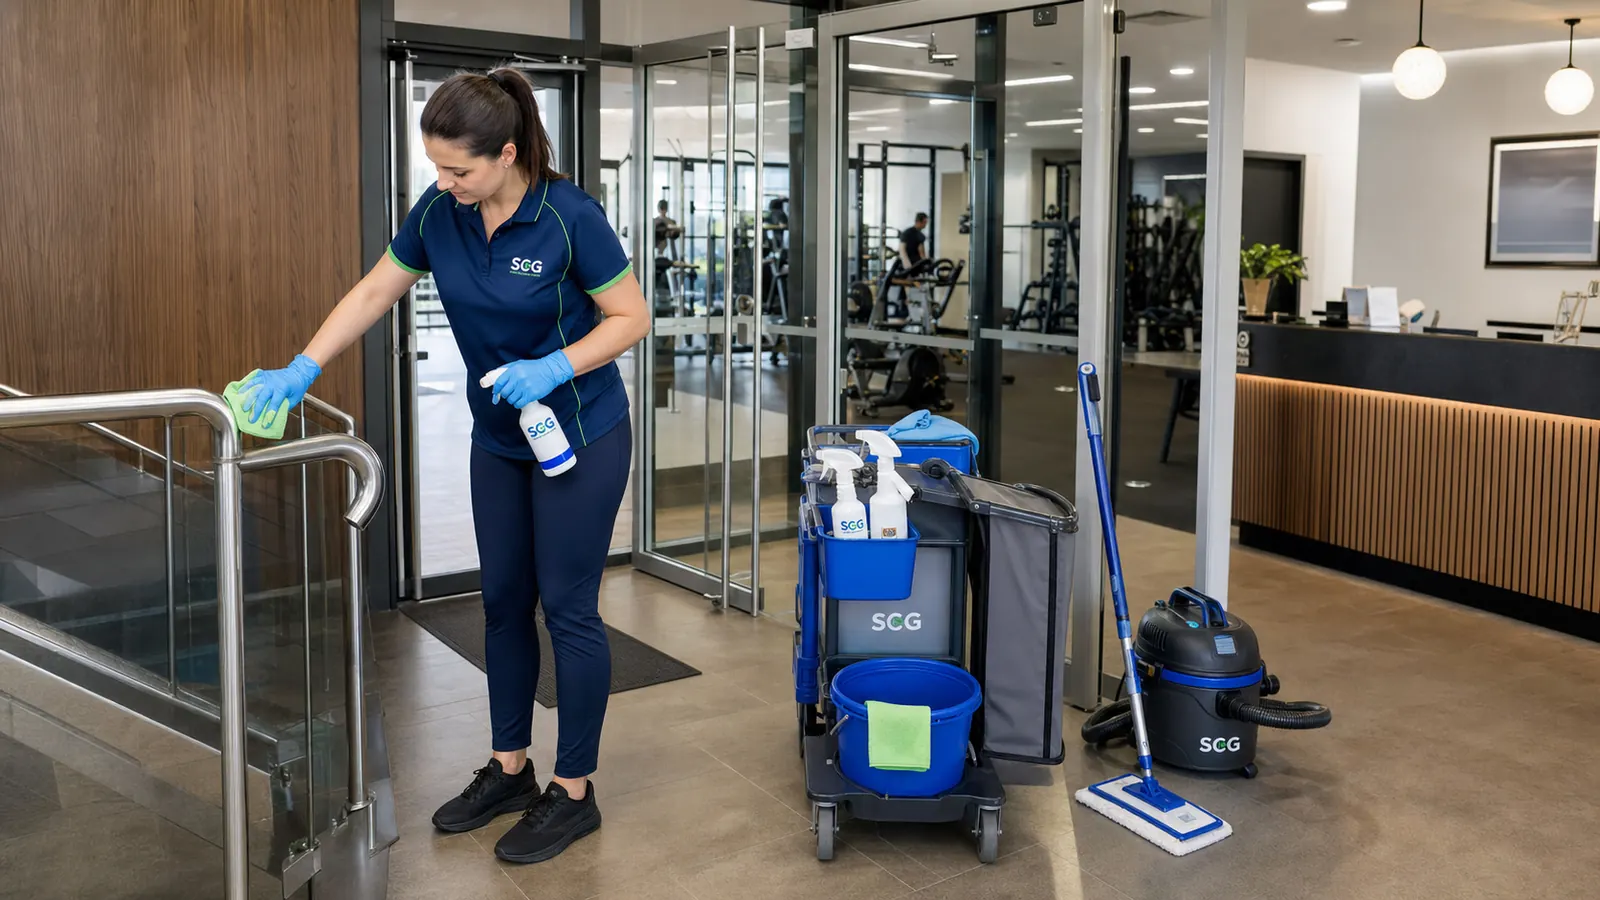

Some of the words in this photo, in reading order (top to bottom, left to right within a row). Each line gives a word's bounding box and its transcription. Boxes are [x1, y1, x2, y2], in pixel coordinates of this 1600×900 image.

[510, 257, 543, 273] SCG
[871, 612, 922, 631] SCG
[1199, 736, 1241, 753] SCG
